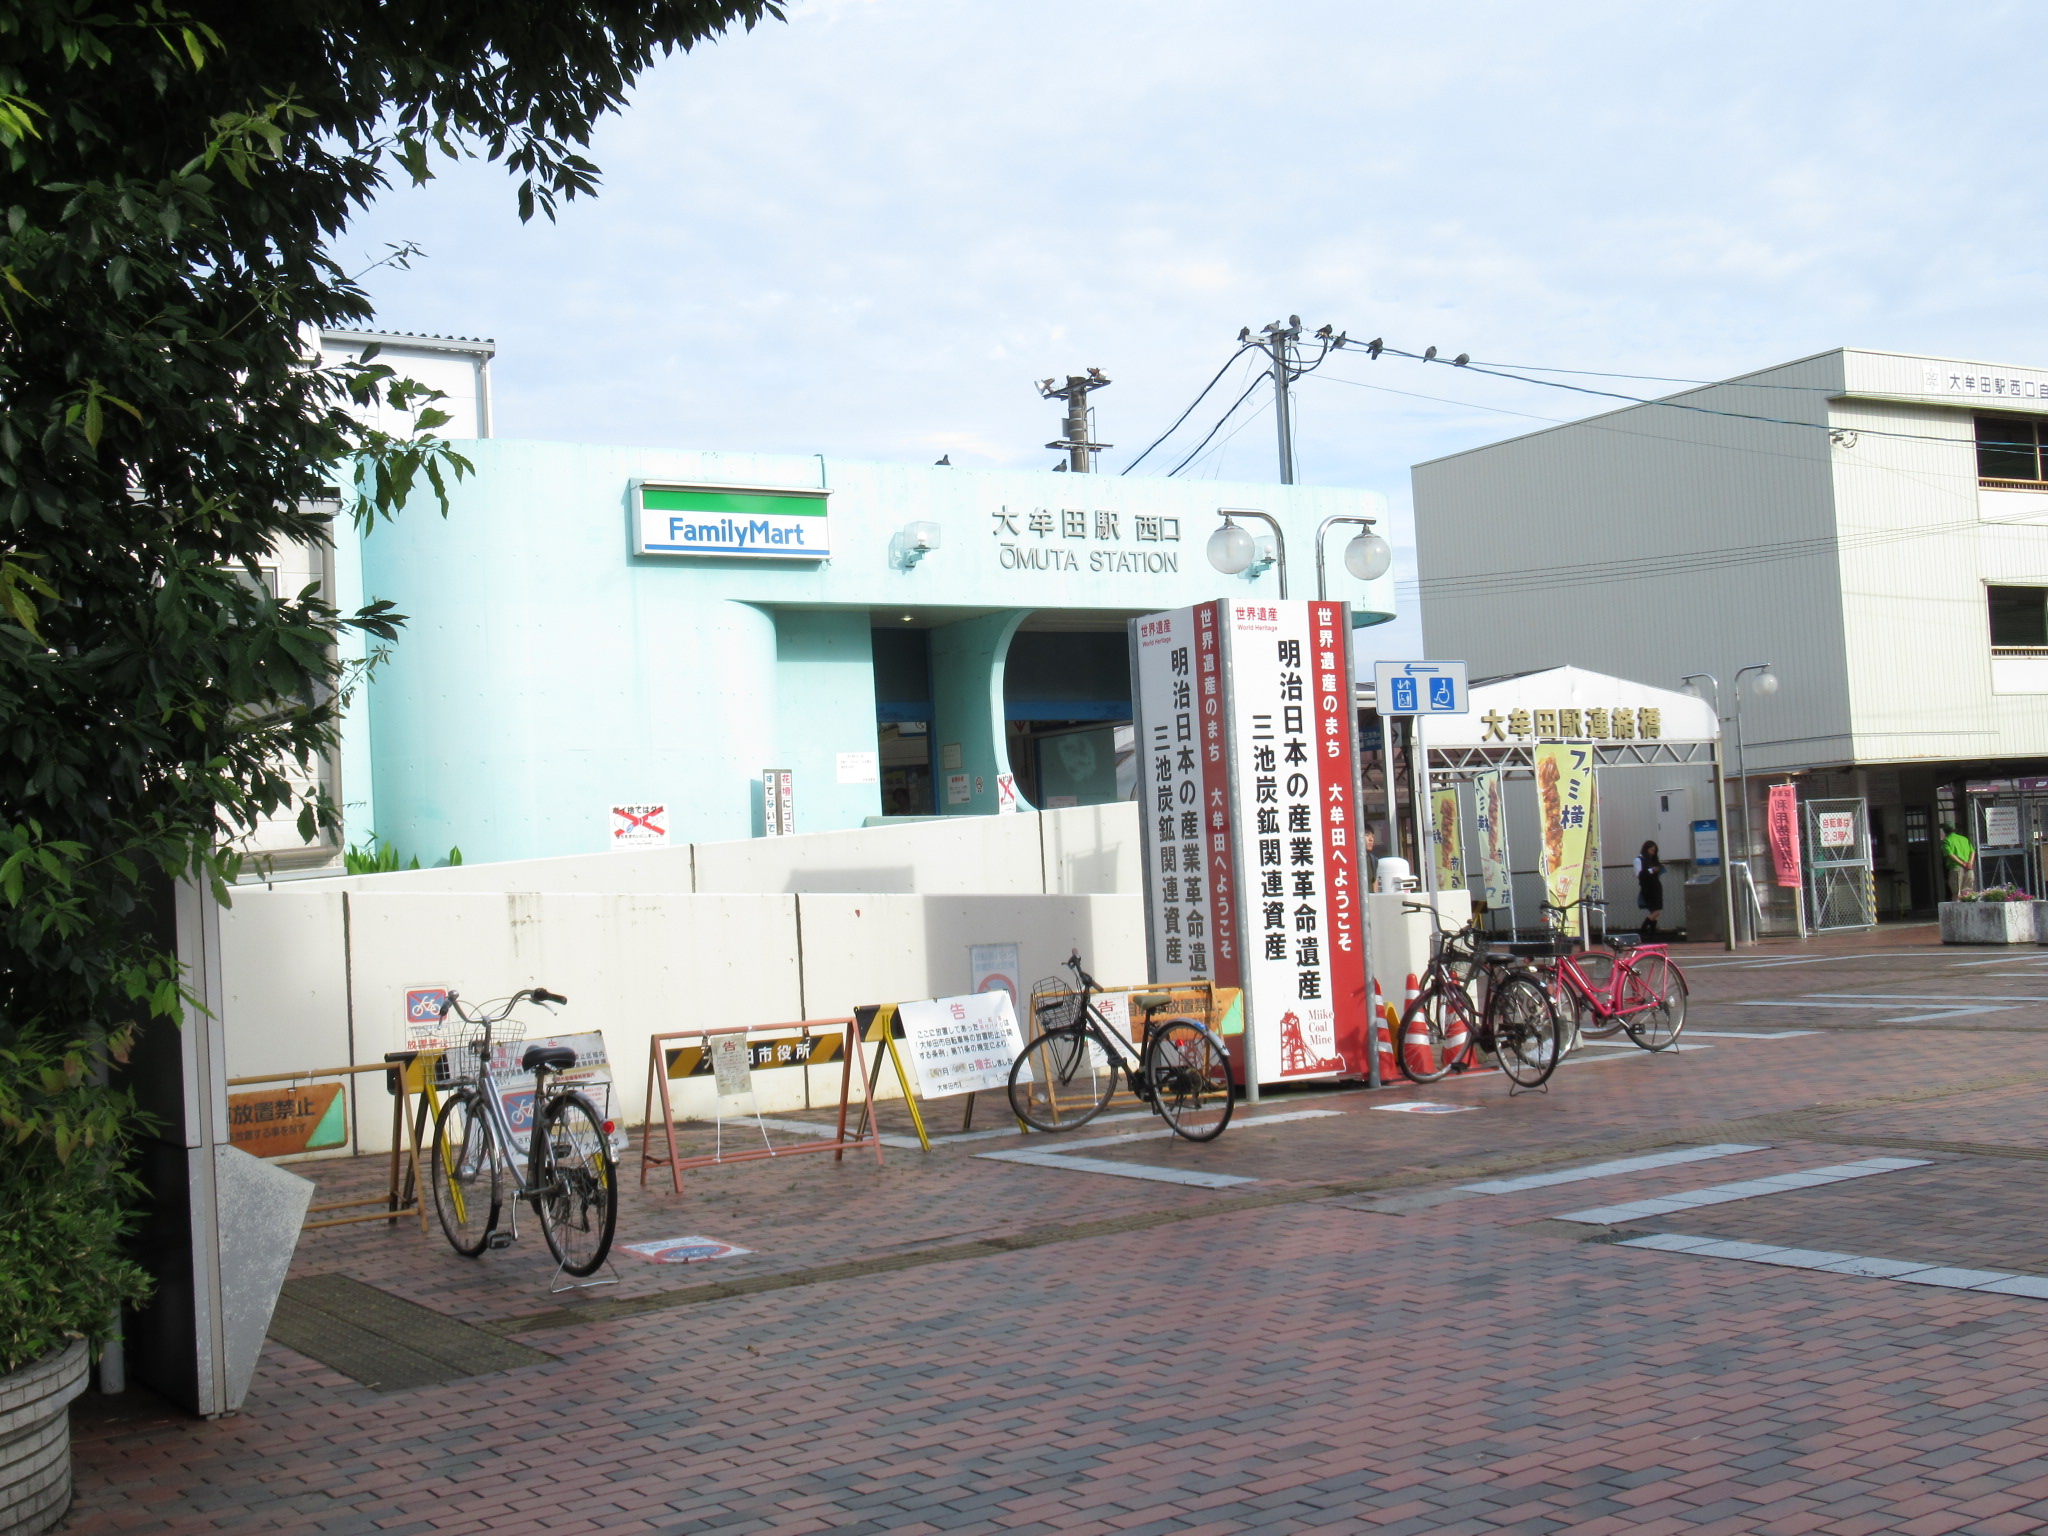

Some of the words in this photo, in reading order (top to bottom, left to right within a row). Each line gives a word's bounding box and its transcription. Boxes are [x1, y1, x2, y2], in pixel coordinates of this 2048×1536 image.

[669, 517, 805, 547] FamilyMart
[992, 505, 1121, 540] 大牟田駅
[1135, 514, 1181, 542] 西口
[1090, 549, 1179, 573] STATION
[1235, 606, 1278, 622] 世界遺産
[1140, 619, 1172, 638] 世界遺産
[1255, 624, 1278, 632] Heritage
[1142, 640, 1154, 648] World
[1154, 637, 1172, 646] Heritage
[1317, 607, 1341, 758] 世界遺産のまち
[1481, 707, 1661, 741] 大牟田駅連絡橋
[1200, 609, 1220, 762] 世界遺産のまち
[1210, 787, 1232, 960] 大牟田へようこそ
[1560, 750, 1590, 829] ファミ横
[766, 774, 775, 833] すてないで
[1277, 639, 1321, 1000] 明治日本の産業革命遺産
[1154, 725, 1182, 964] 三池炭鉱関連資産
[1252, 714, 1287, 961] 三池炭鉱関連資産
[1328, 783, 1352, 952] 大牟田へようこそ
[950, 1003, 966, 1020] 告
[1097, 1000, 1116, 1013] 告
[1308, 1009, 1334, 1021] Miike
[1308, 1021, 1328, 1033] Coal
[1310, 1034, 1332, 1045] Mine
[701, 1043, 811, 1069] 大市役所
[723, 1041, 737, 1052] 告
[229, 1097, 315, 1124] 放置禁止
